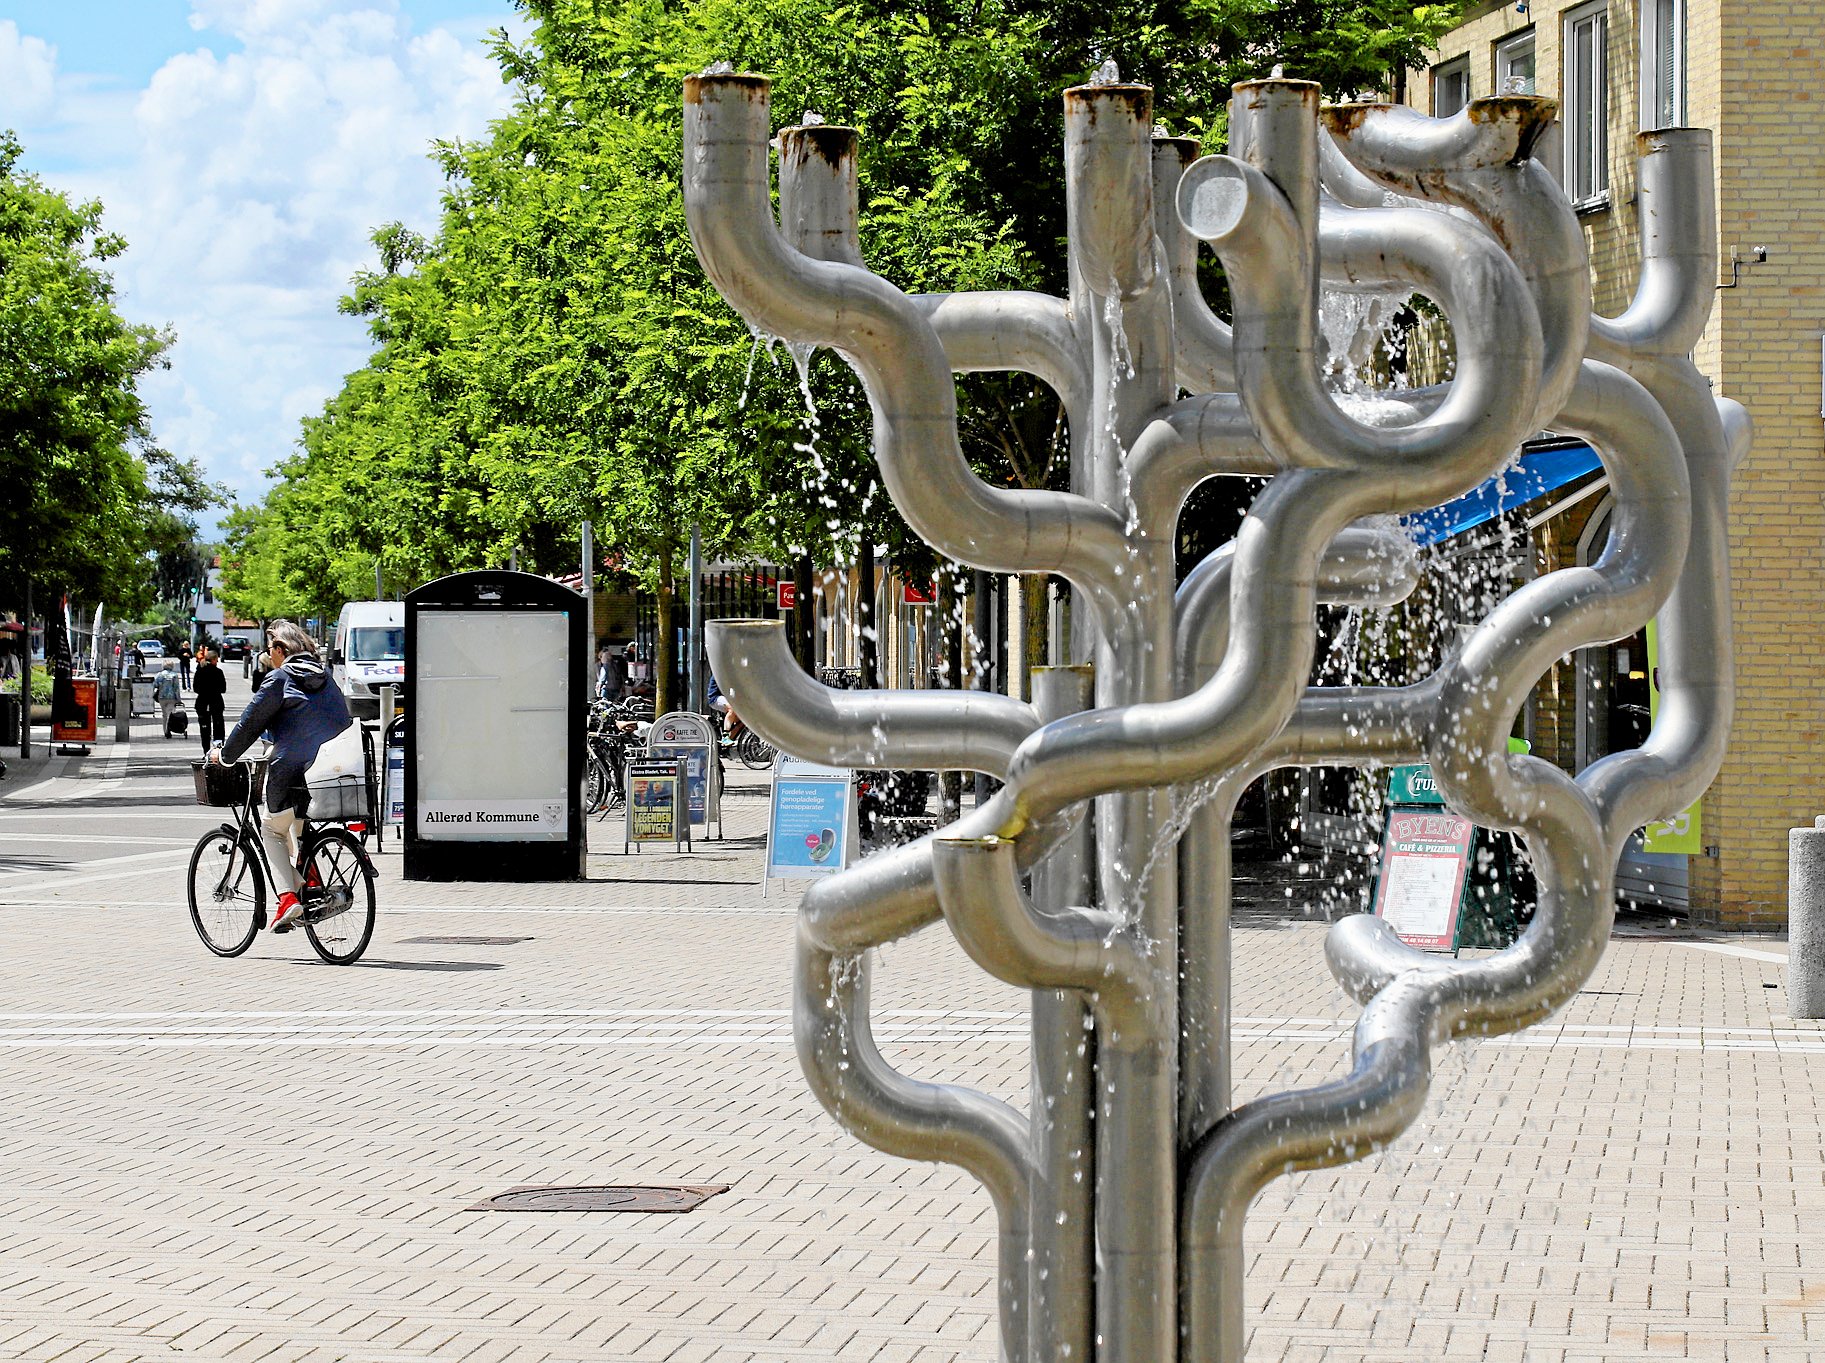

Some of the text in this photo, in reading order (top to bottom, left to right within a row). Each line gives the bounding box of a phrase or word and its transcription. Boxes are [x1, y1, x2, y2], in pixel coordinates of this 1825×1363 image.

[781, 788, 804, 796] Fordele
[781, 796, 825, 804] genopladelige
[425, 811, 540, 823] Allerød Kommune
[634, 813, 671, 823] LEGENDEN
[1397, 816, 1466, 840] BYENS
[1399, 843, 1416, 852] CAFÉ
[1425, 844, 1456, 853] PIZZERIA
